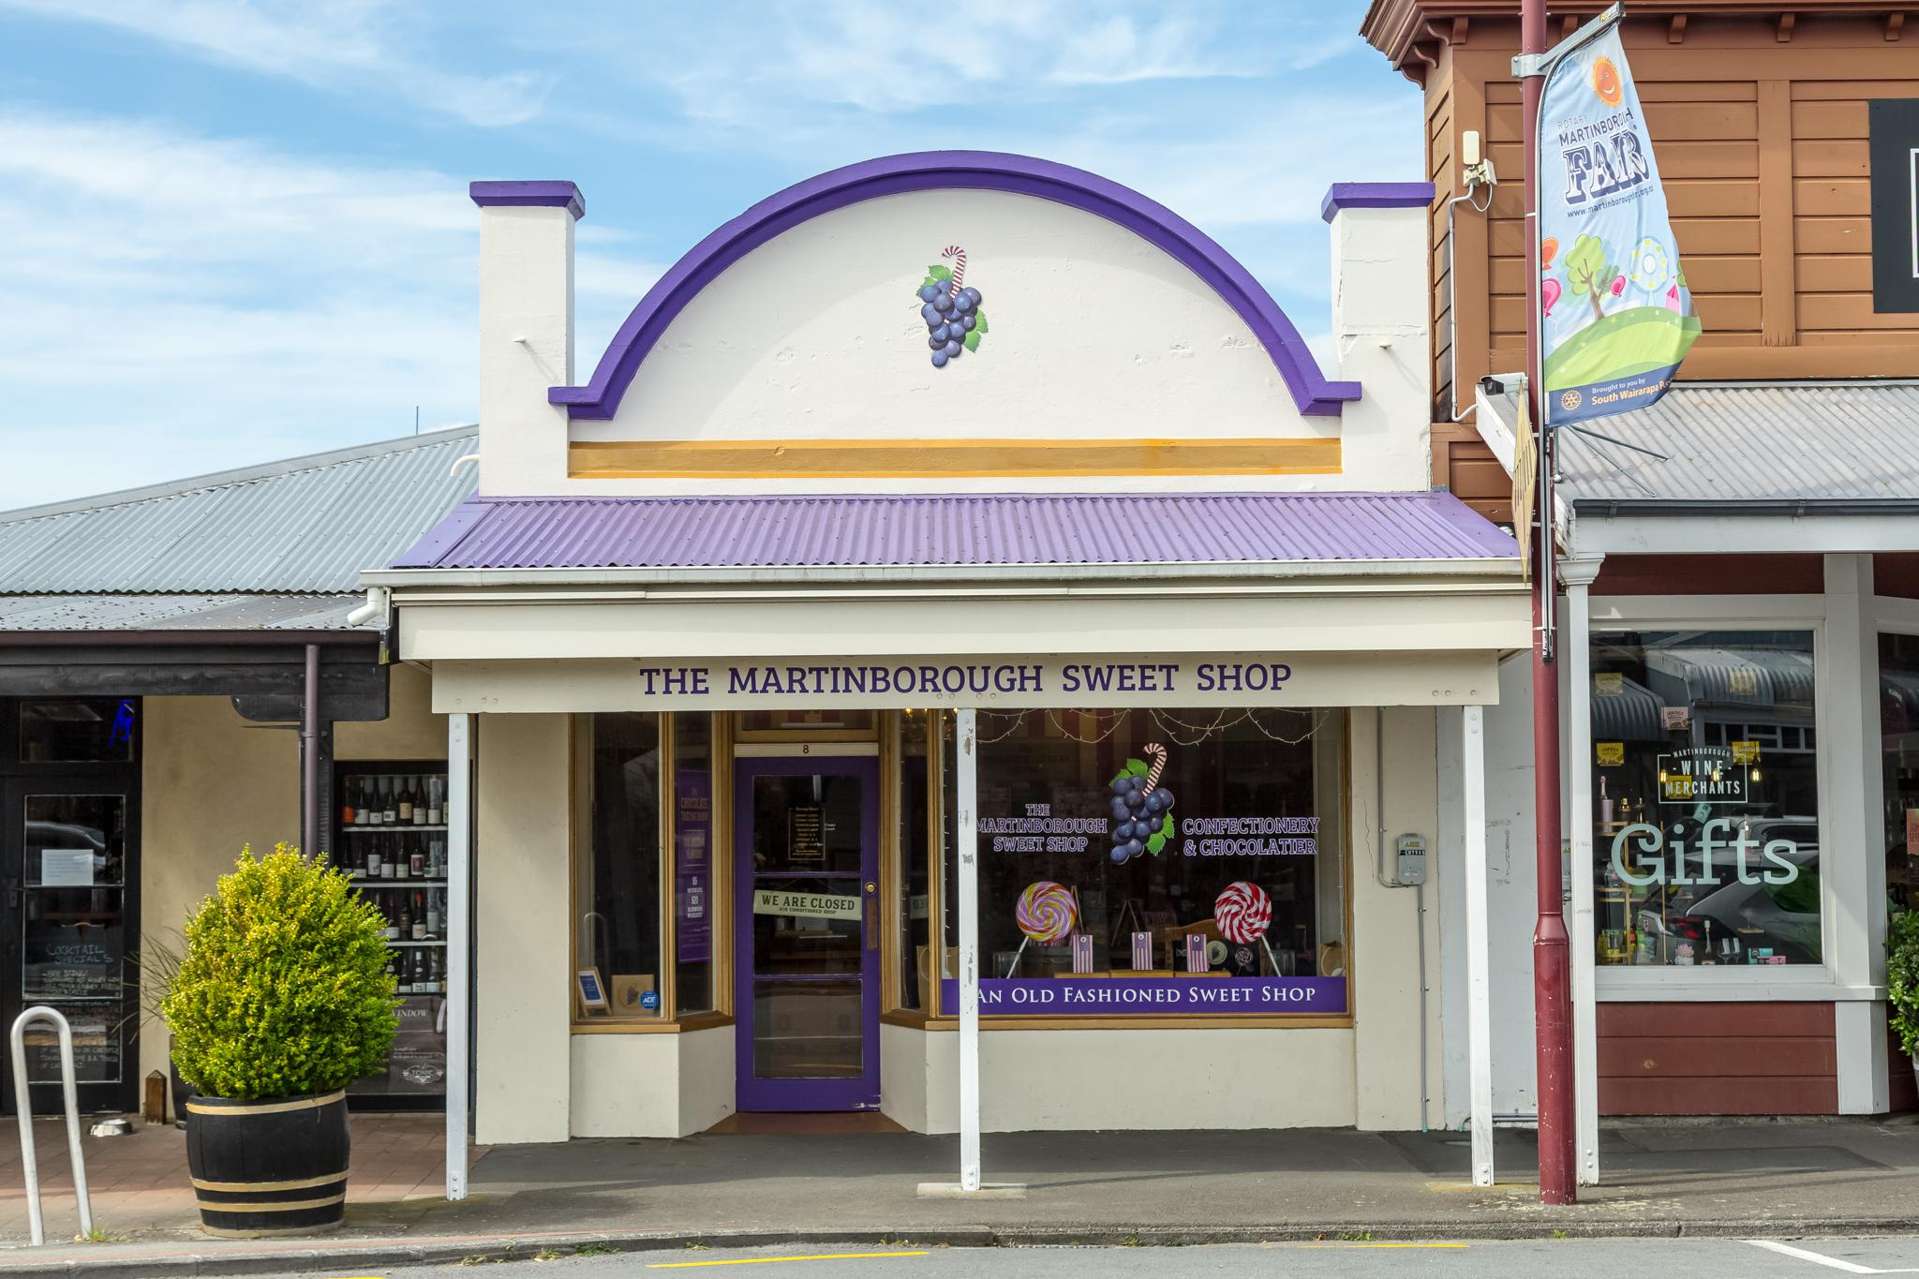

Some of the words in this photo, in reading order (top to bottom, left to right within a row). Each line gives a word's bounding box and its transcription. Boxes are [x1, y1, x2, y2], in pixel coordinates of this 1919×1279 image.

[1592, 382, 1618, 394] Brought
[1626, 380, 1638, 389] you
[1592, 391, 1618, 405] South
[1619, 385, 1659, 401] Wairarapa
[640, 667, 709, 695] THE
[728, 665, 1043, 694] MARTINBOROUGH
[1062, 663, 1179, 692] SWEET
[1197, 662, 1291, 691] SHOP
[802, 744, 810, 754] 8
[1681, 760, 1724, 778] WINE
[1665, 780, 1740, 797] MERCHANTS
[1025, 803, 1051, 817] THE
[976, 818, 1108, 834] MARTINBOROUGH
[1182, 817, 1320, 835] CONFECTIONERY
[993, 837, 1045, 852] SWEET
[1046, 836, 1089, 852] SHOP
[1183, 839, 1197, 856] &
[1199, 838, 1319, 856] CHOCOLATIER
[1610, 818, 1799, 886] Gifts
[762, 894, 779, 906] WE
[783, 896, 807, 908] ARE
[810, 897, 855, 911] CLOSED
[1011, 987, 1055, 1004] OLD
[1063, 987, 1181, 1003] FASHIONED
[1188, 986, 1254, 1003] SWEET
[1261, 986, 1317, 1002] SHOP
